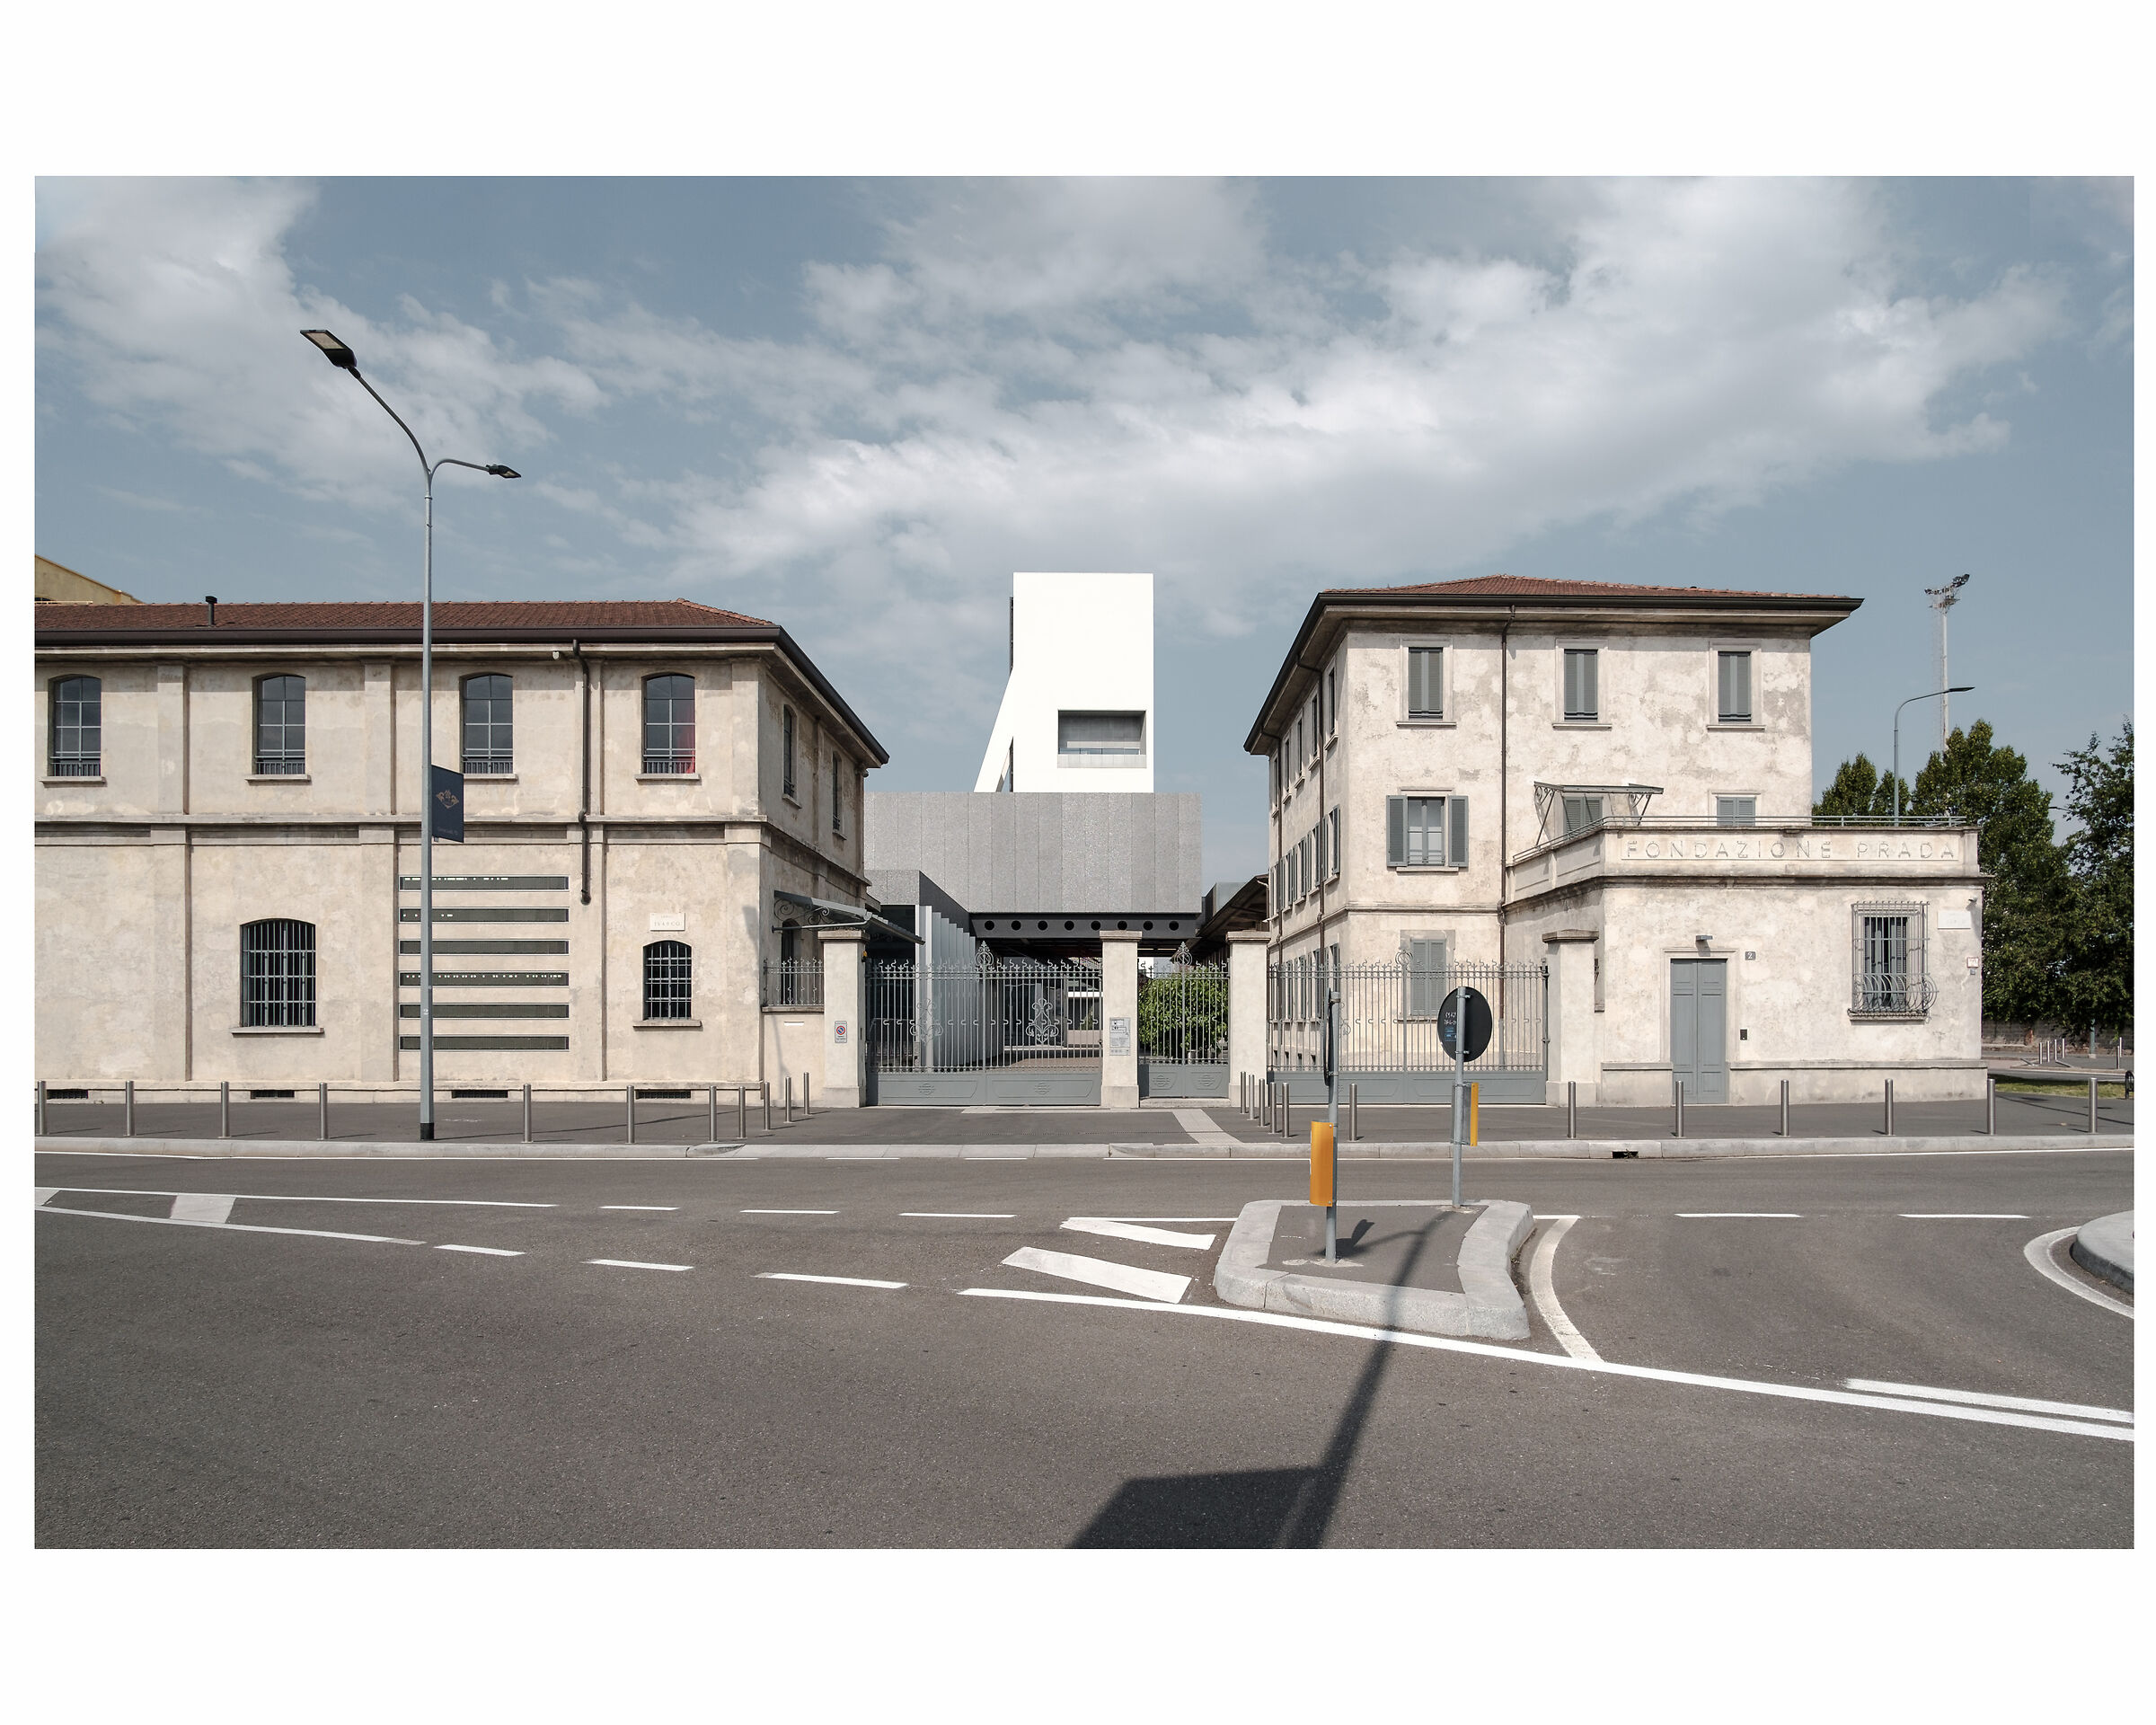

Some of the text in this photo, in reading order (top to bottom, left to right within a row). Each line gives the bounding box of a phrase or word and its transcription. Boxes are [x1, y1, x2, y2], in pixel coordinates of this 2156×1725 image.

[1627, 840, 1954, 859] FONDAZIONE PRADA
[1747, 951, 1753, 960] 2
